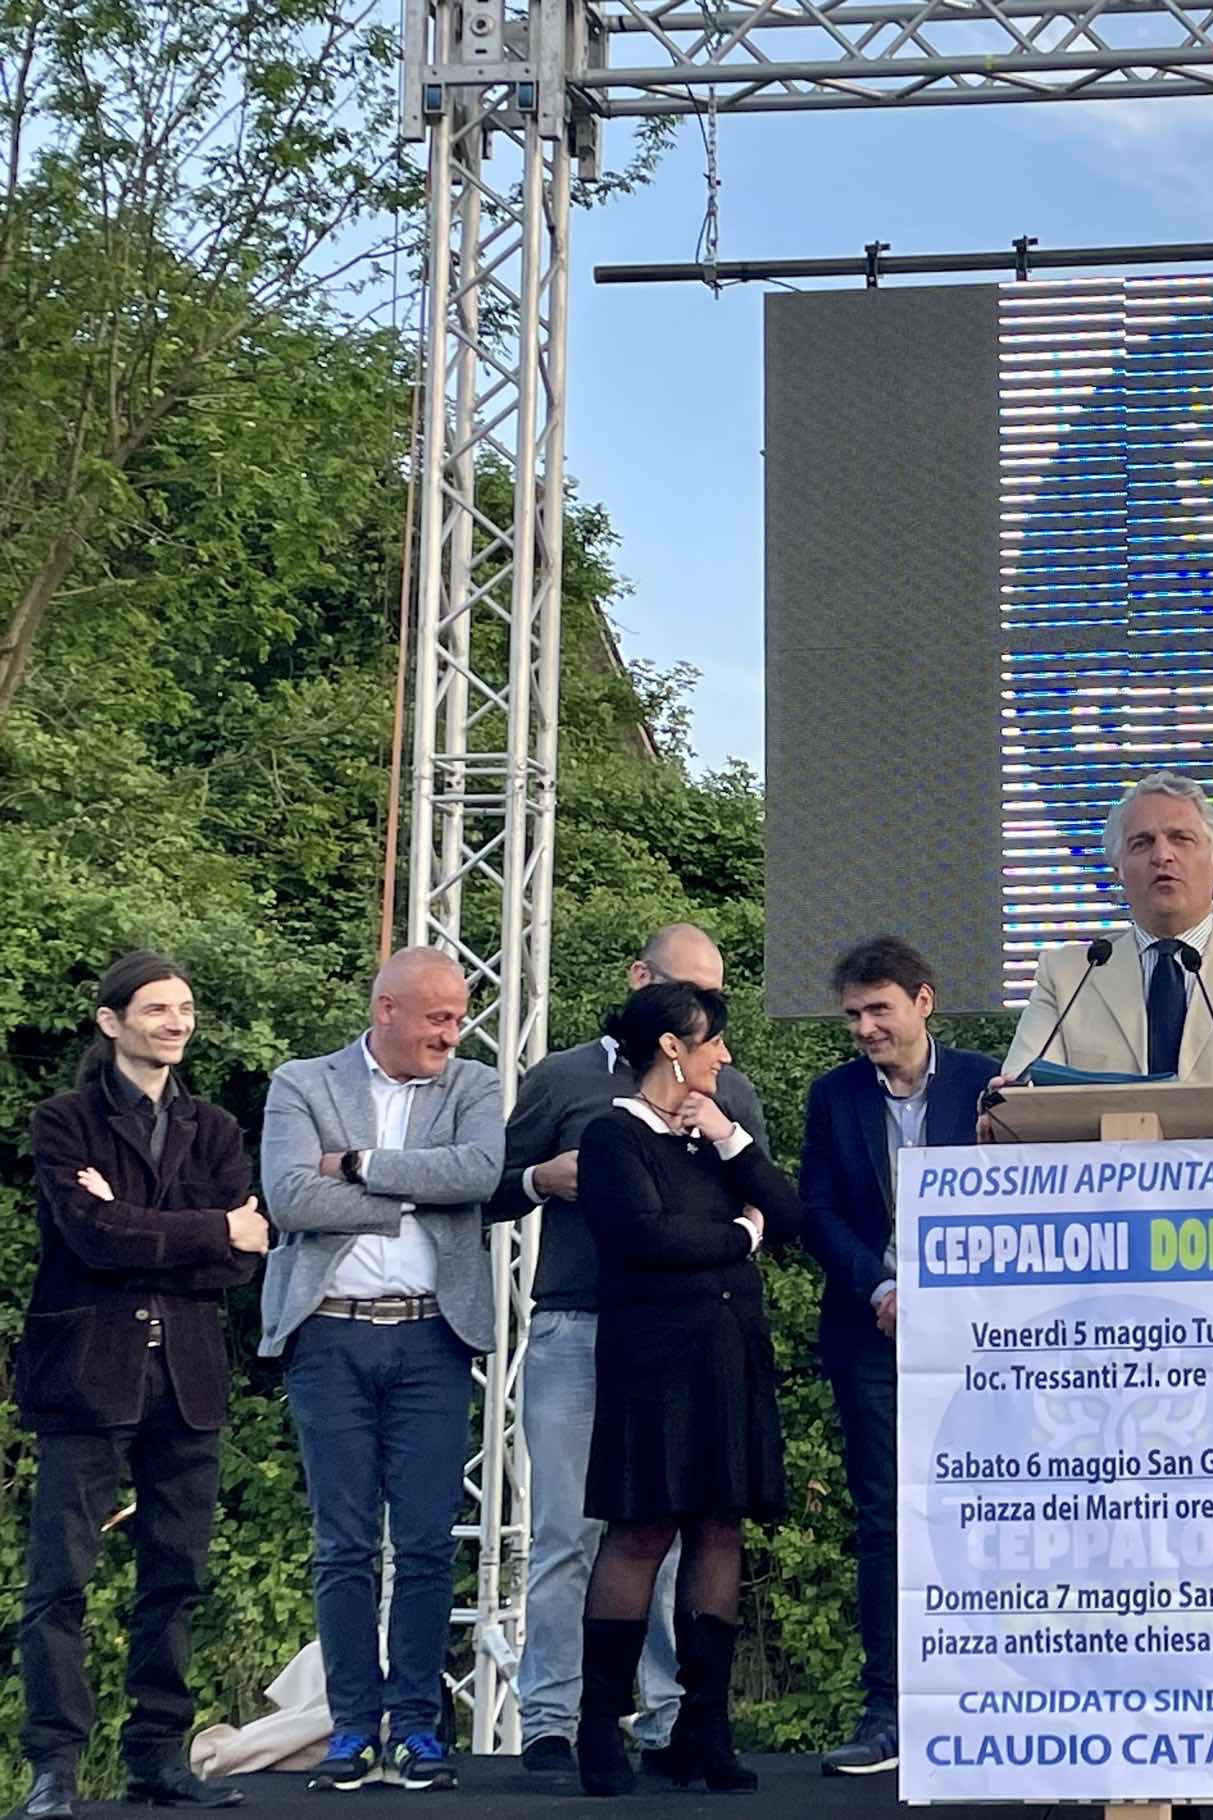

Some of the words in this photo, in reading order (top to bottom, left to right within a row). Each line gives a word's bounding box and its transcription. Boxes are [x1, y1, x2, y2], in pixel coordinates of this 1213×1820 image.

[918, 1164, 1068, 1198] PROSSIMI
[924, 1222, 1129, 1275] CEPPALONI
[972, 1318, 1067, 1348] Venerdì
[1073, 1318, 1088, 1346] 5
[1093, 1316, 1188, 1352] maggio
[965, 1364, 1007, 1392] loc.
[1010, 1363, 1118, 1390] Tressanti
[1123, 1362, 1161, 1388] Z.I.
[1166, 1367, 1207, 1388] ore
[935, 1450, 1020, 1479] Sabato
[1026, 1451, 1042, 1477] 6
[1047, 1449, 1141, 1484] maggio
[1147, 1449, 1194, 1475] San
[960, 1493, 1036, 1529] piazza
[1041, 1495, 1080, 1521] dei
[1085, 1494, 1169, 1521] Martiri
[925, 1582, 1050, 1611] Domenica
[1056, 1584, 1071, 1610] 7
[1077, 1581, 1173, 1616] maggio
[921, 1627, 999, 1663] piazza
[1003, 1627, 1130, 1654] antistante
[1134, 1625, 1212, 1653] chiesa
[957, 1688, 1148, 1715] CANDIDATO
[925, 1734, 1112, 1766] CLAUDIO
